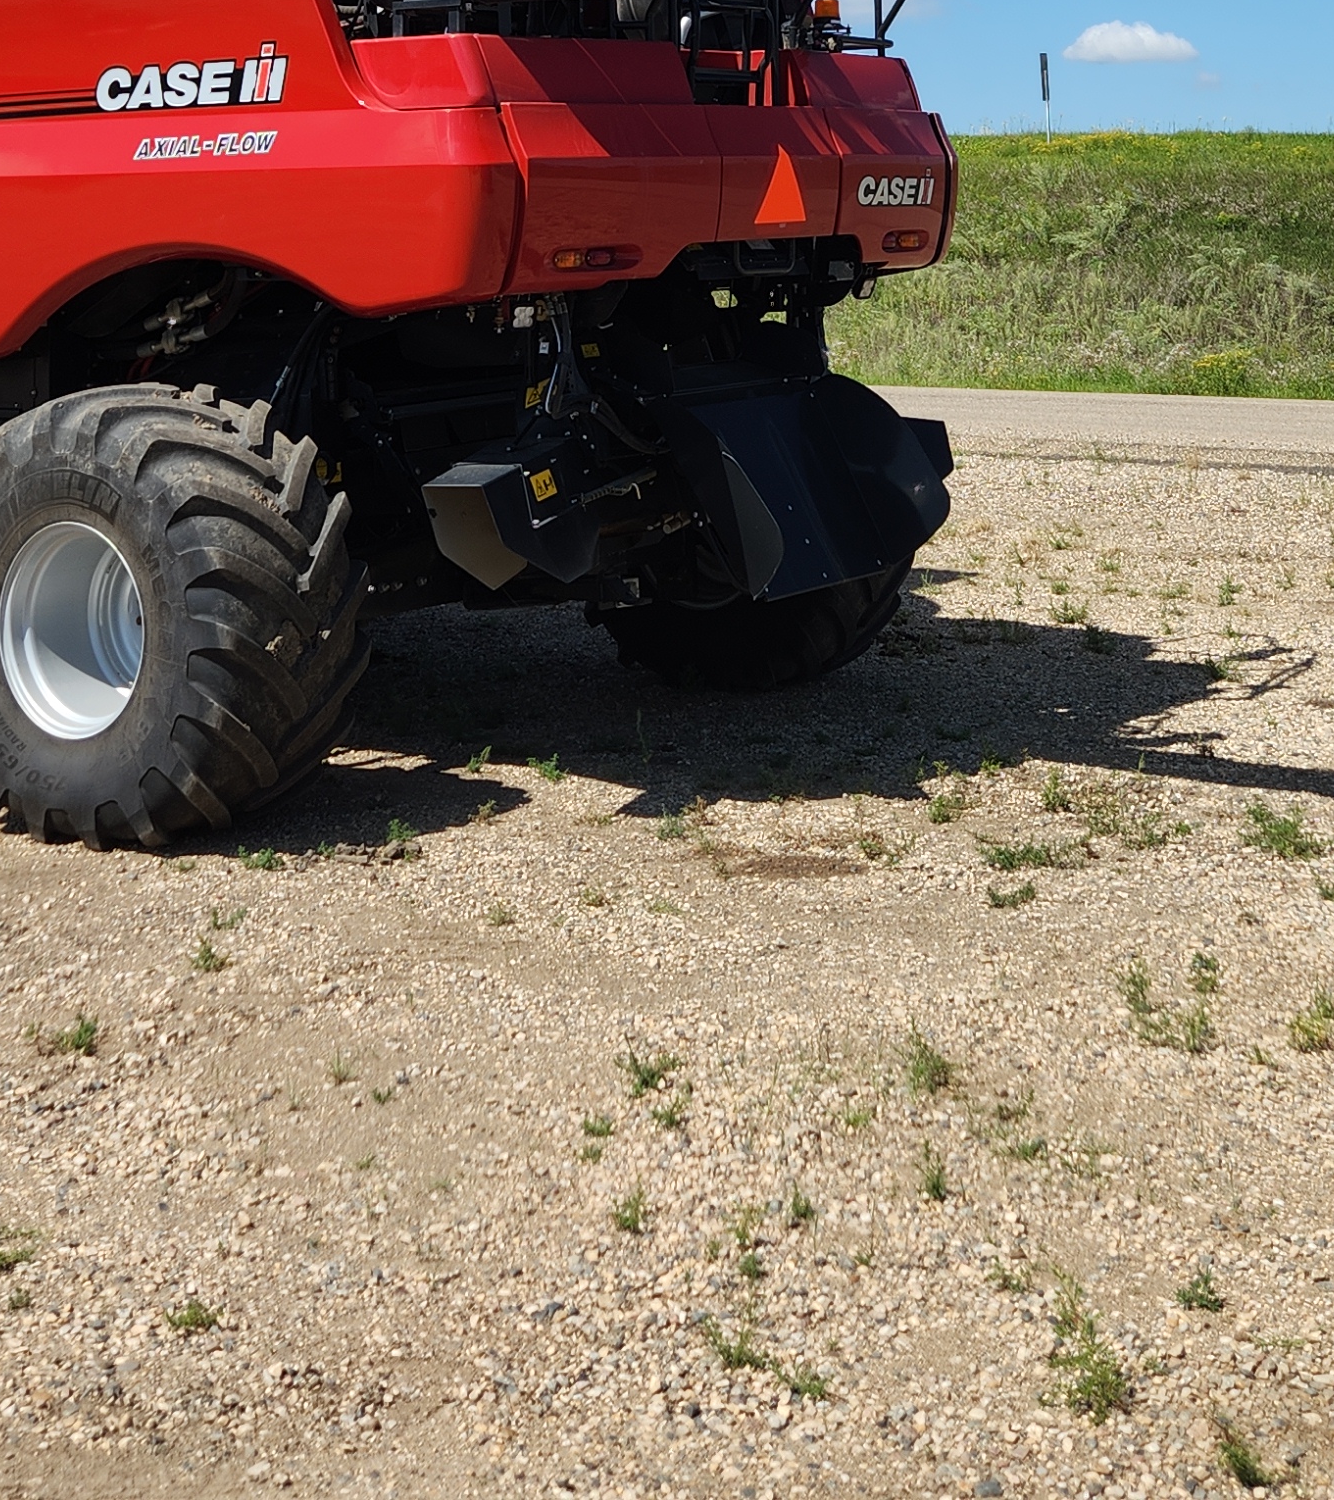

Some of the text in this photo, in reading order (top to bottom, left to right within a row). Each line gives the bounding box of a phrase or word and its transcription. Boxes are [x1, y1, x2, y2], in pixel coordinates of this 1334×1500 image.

[96, 61, 235, 111] CASE
[133, 131, 277, 160] AXIAL-FLOW
[858, 176, 917, 205] CASE
